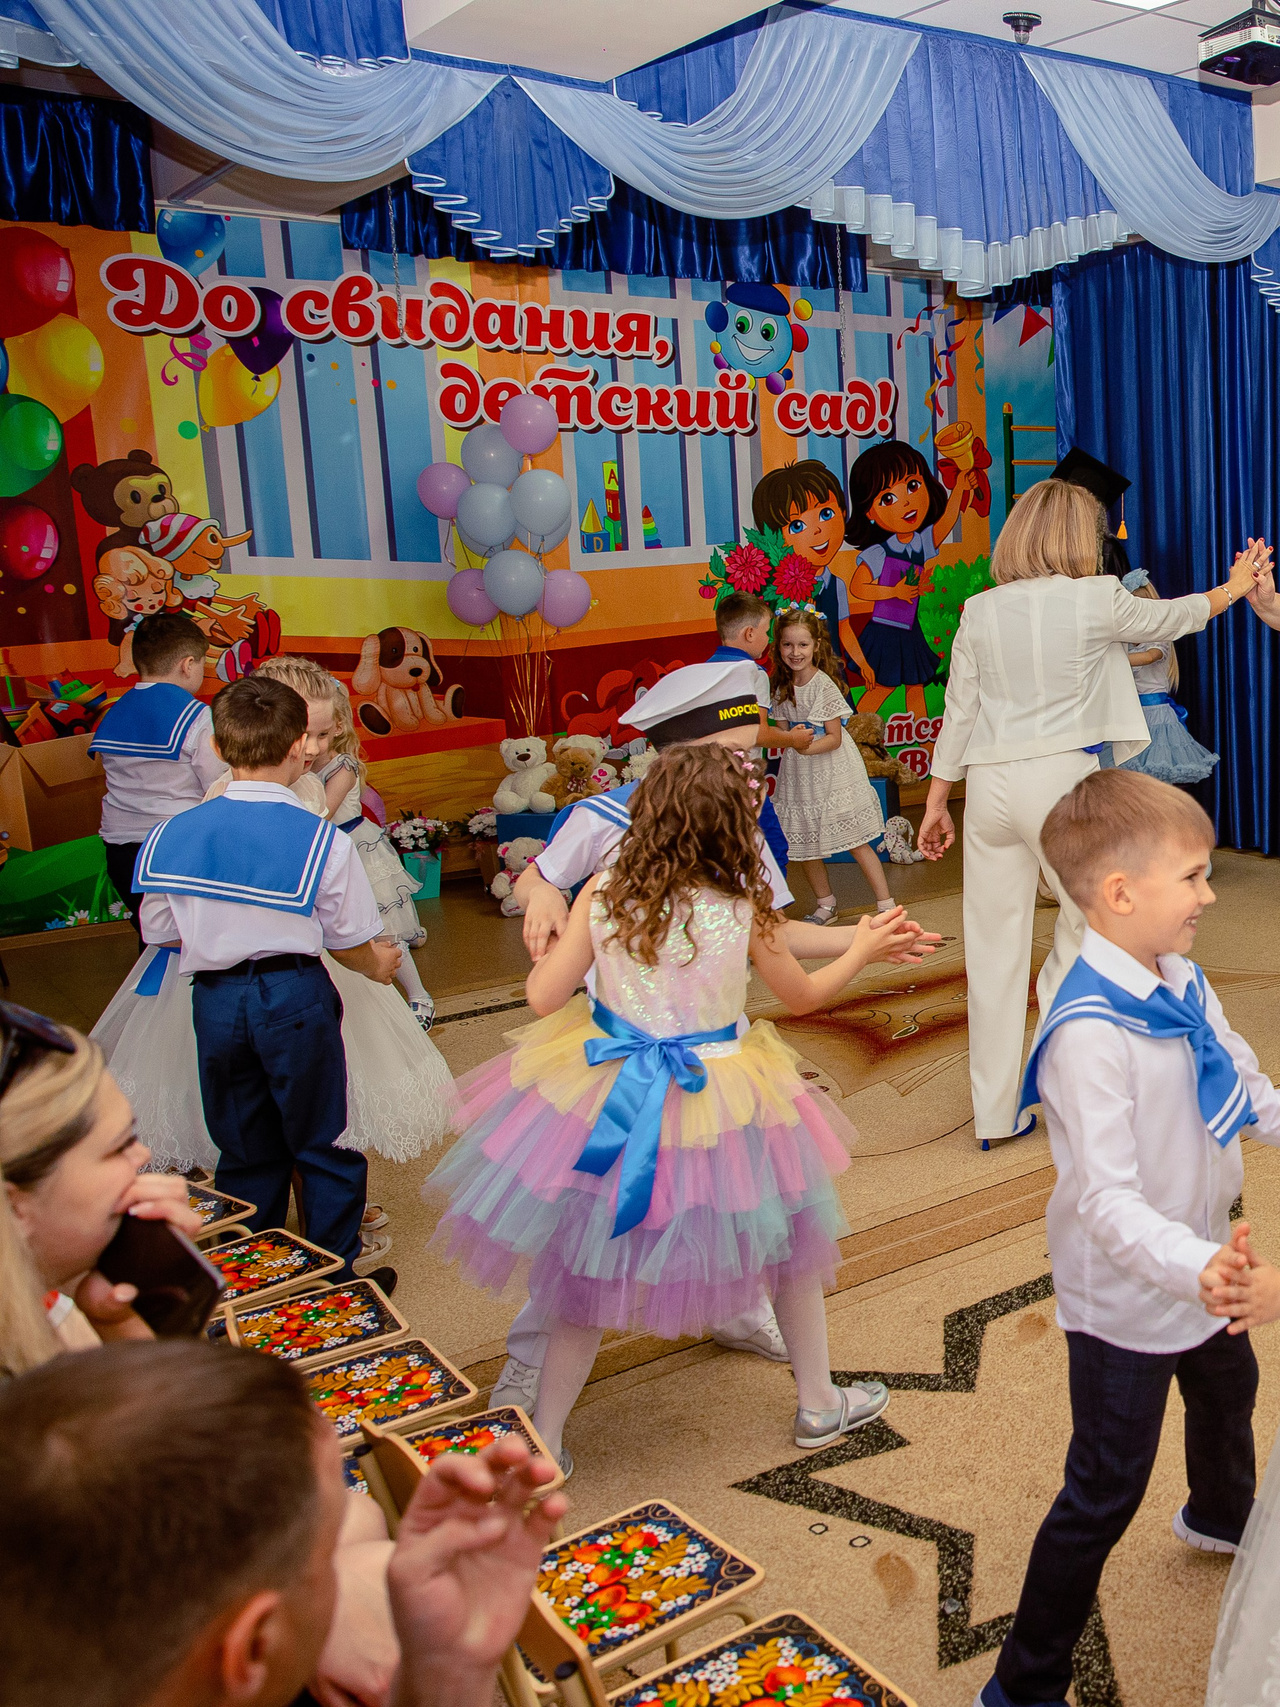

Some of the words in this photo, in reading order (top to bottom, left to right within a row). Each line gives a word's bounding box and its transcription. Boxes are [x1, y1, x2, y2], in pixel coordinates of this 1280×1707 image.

[101, 254, 261, 336] До
[284, 272, 672, 365] свидания,
[438, 362, 757, 431] детский
[776, 380, 896, 434] сад!
